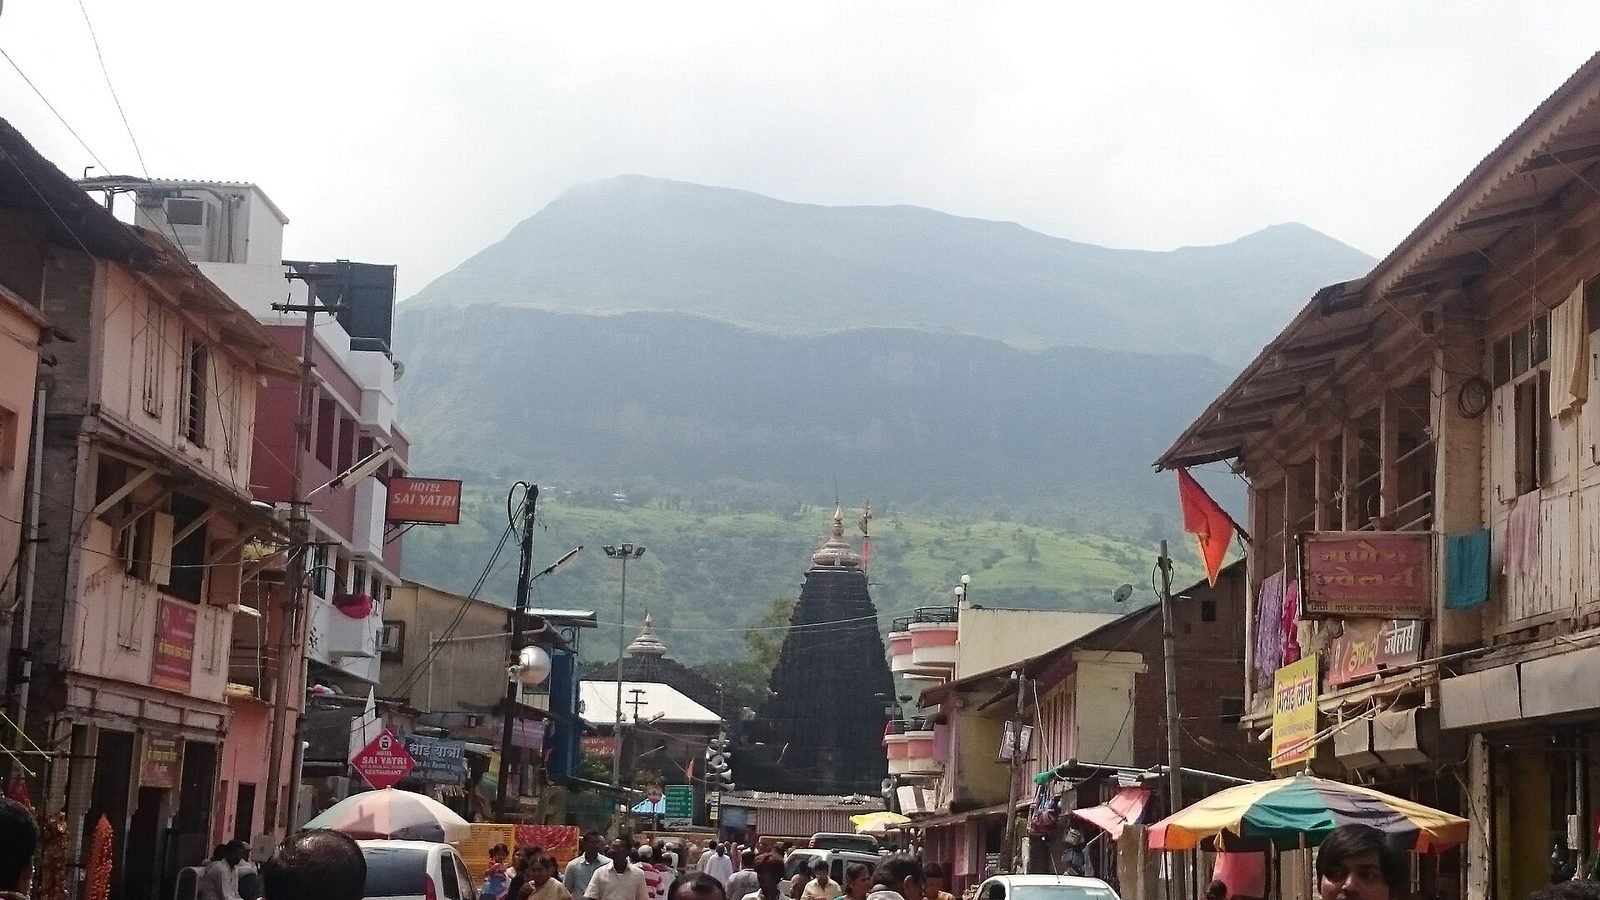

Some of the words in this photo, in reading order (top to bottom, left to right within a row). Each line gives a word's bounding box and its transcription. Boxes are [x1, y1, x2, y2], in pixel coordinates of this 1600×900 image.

[410, 482, 441, 492] HOTEL
[393, 493, 415, 505] SAI
[420, 494, 456, 506] YATRI
[362, 756, 378, 764] SAI
[380, 756, 407, 765] YATRI
